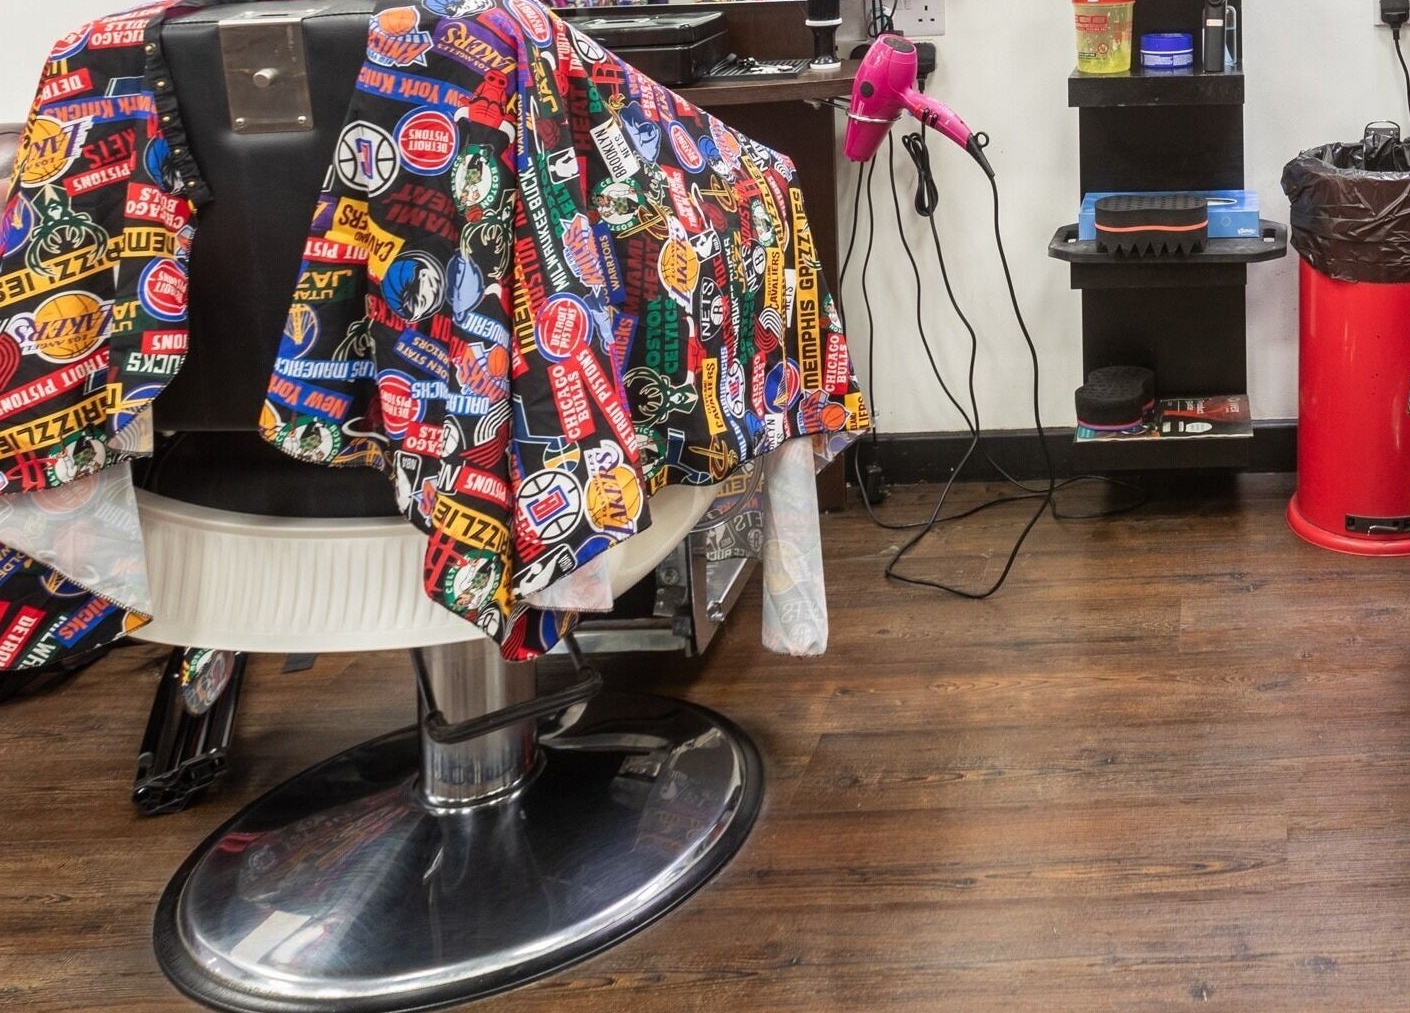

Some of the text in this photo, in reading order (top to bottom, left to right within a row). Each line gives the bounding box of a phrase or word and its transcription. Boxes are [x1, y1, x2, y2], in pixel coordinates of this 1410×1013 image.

[440, 22, 516, 75] LAKERS
[400, 77, 439, 103] York
[408, 128, 449, 142] PISTONS
[408, 140, 449, 155] DETROIT
[594, 127, 627, 179] BROOKLYN
[614, 133, 631, 158] NETS
[72, 163, 131, 192] PISTONS
[532, 209, 570, 292] MILWAUKEE
[600, 235, 621, 291] WARRIORS
[741, 243, 760, 293] NETS
[769, 251, 781, 310] CAVALIERS
[17, 300, 113, 345] LAKERS
[550, 304, 567, 346] DETROIT
[560, 307, 578, 348] PISTONS
[646, 294, 662, 369] OSTON
[700, 281, 713, 337] NETS
[396, 342, 427, 368] STATE
[800, 299, 818, 390] MEMPHIS
[825, 335, 840, 393] CHICAGO
[836, 344, 848, 384] BULLS
[304, 389, 350, 419] New
[445, 393, 489, 415] DALLA
[552, 364, 582, 439] CHICAGO
[567, 371, 591, 422] BULLS
[576, 348, 639, 454] DETROIT PISTONS
[401, 454, 418, 472] NBA
[464, 471, 508, 503] PISTONS
